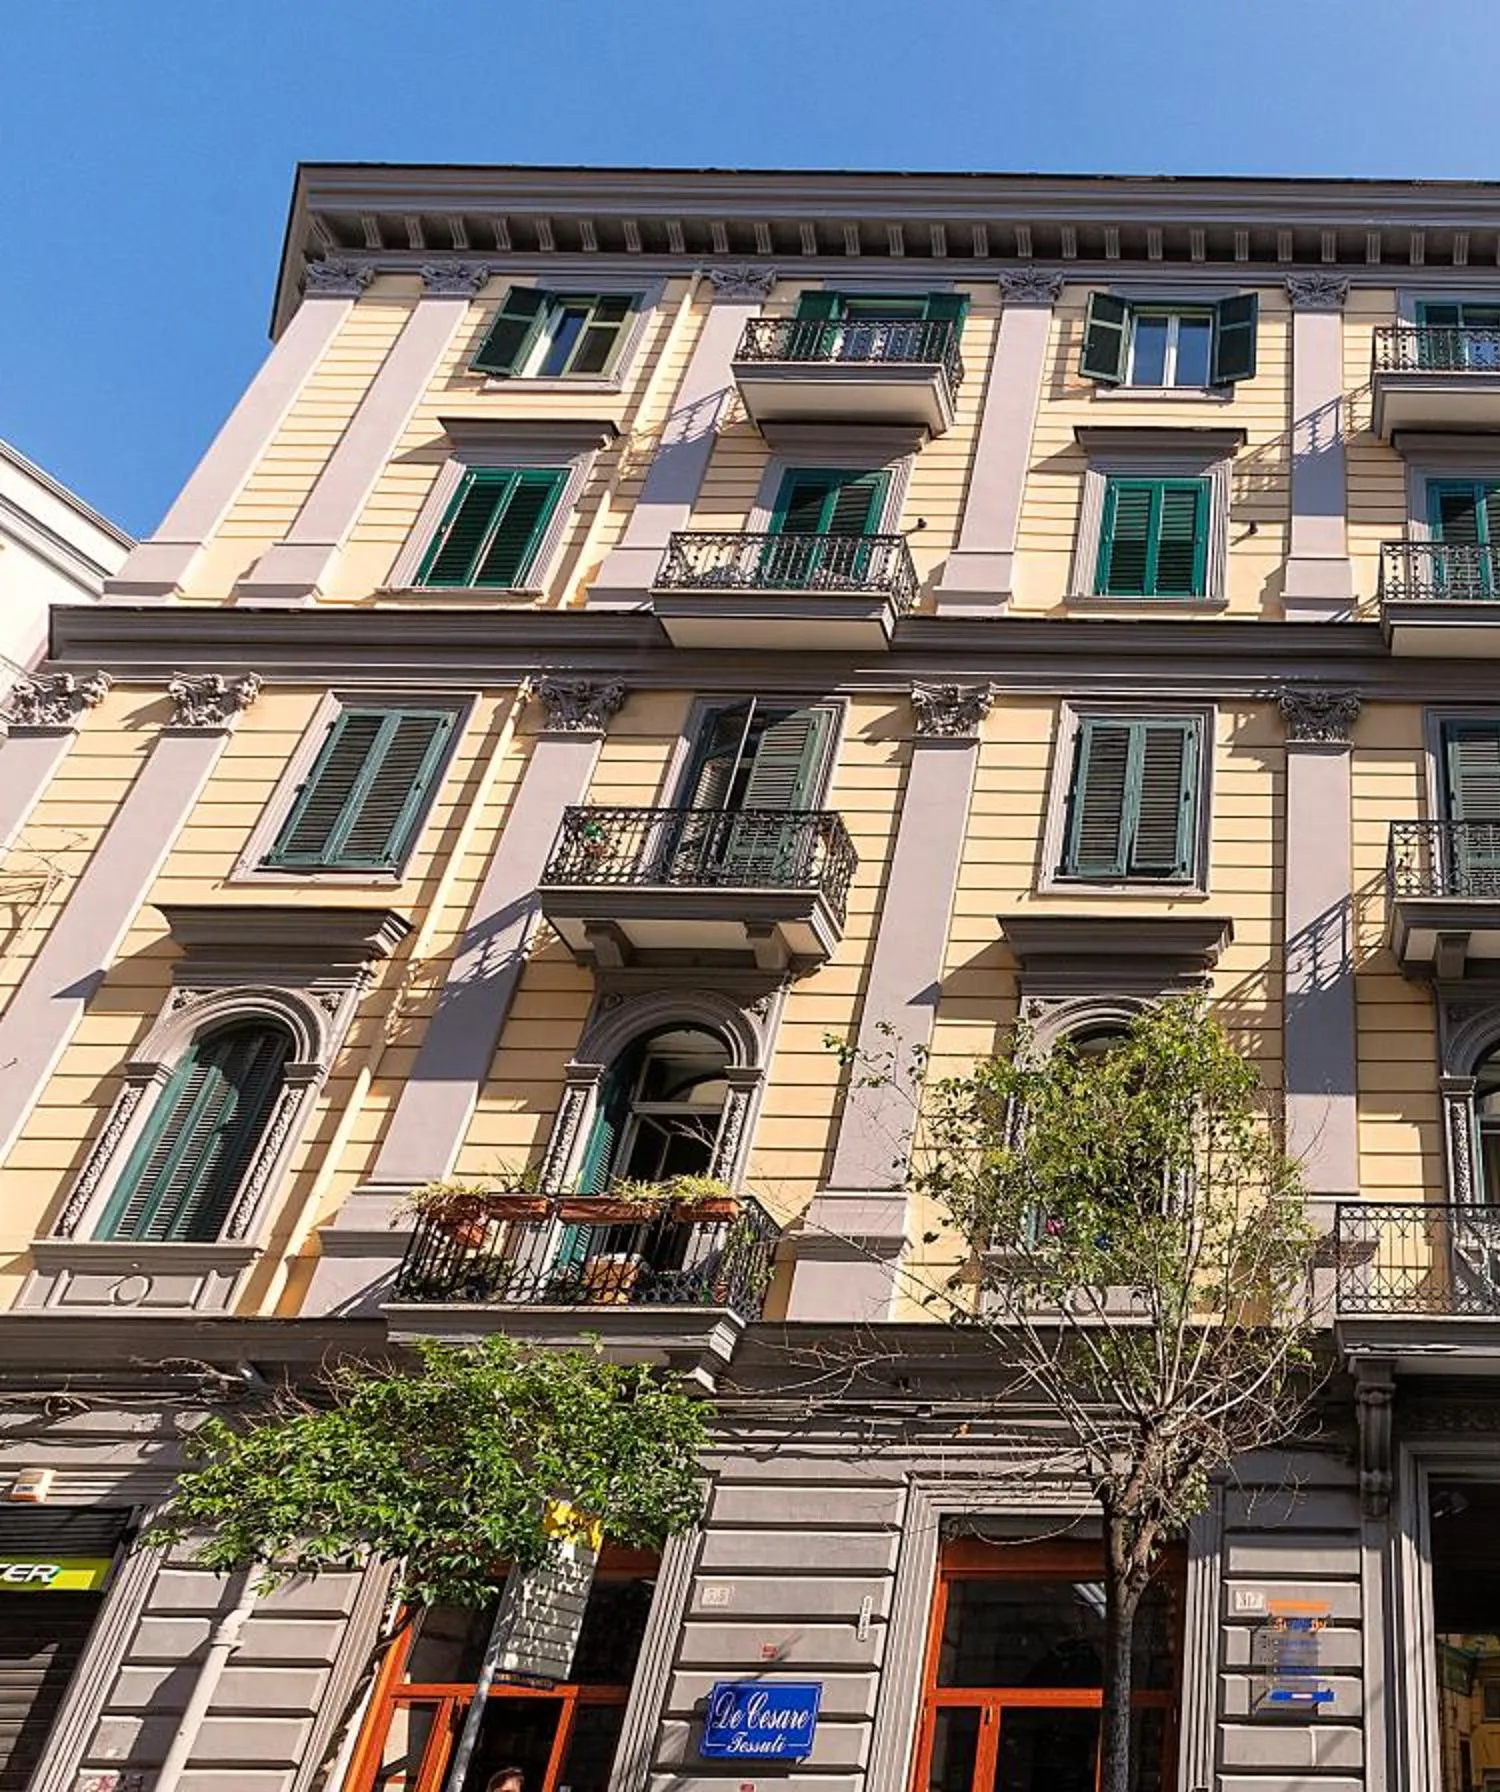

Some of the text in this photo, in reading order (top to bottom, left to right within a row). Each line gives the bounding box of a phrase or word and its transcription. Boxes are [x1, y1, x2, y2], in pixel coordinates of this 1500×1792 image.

[712, 1691, 811, 1730] De Cesare
[726, 1731, 787, 1753] Tessuti
